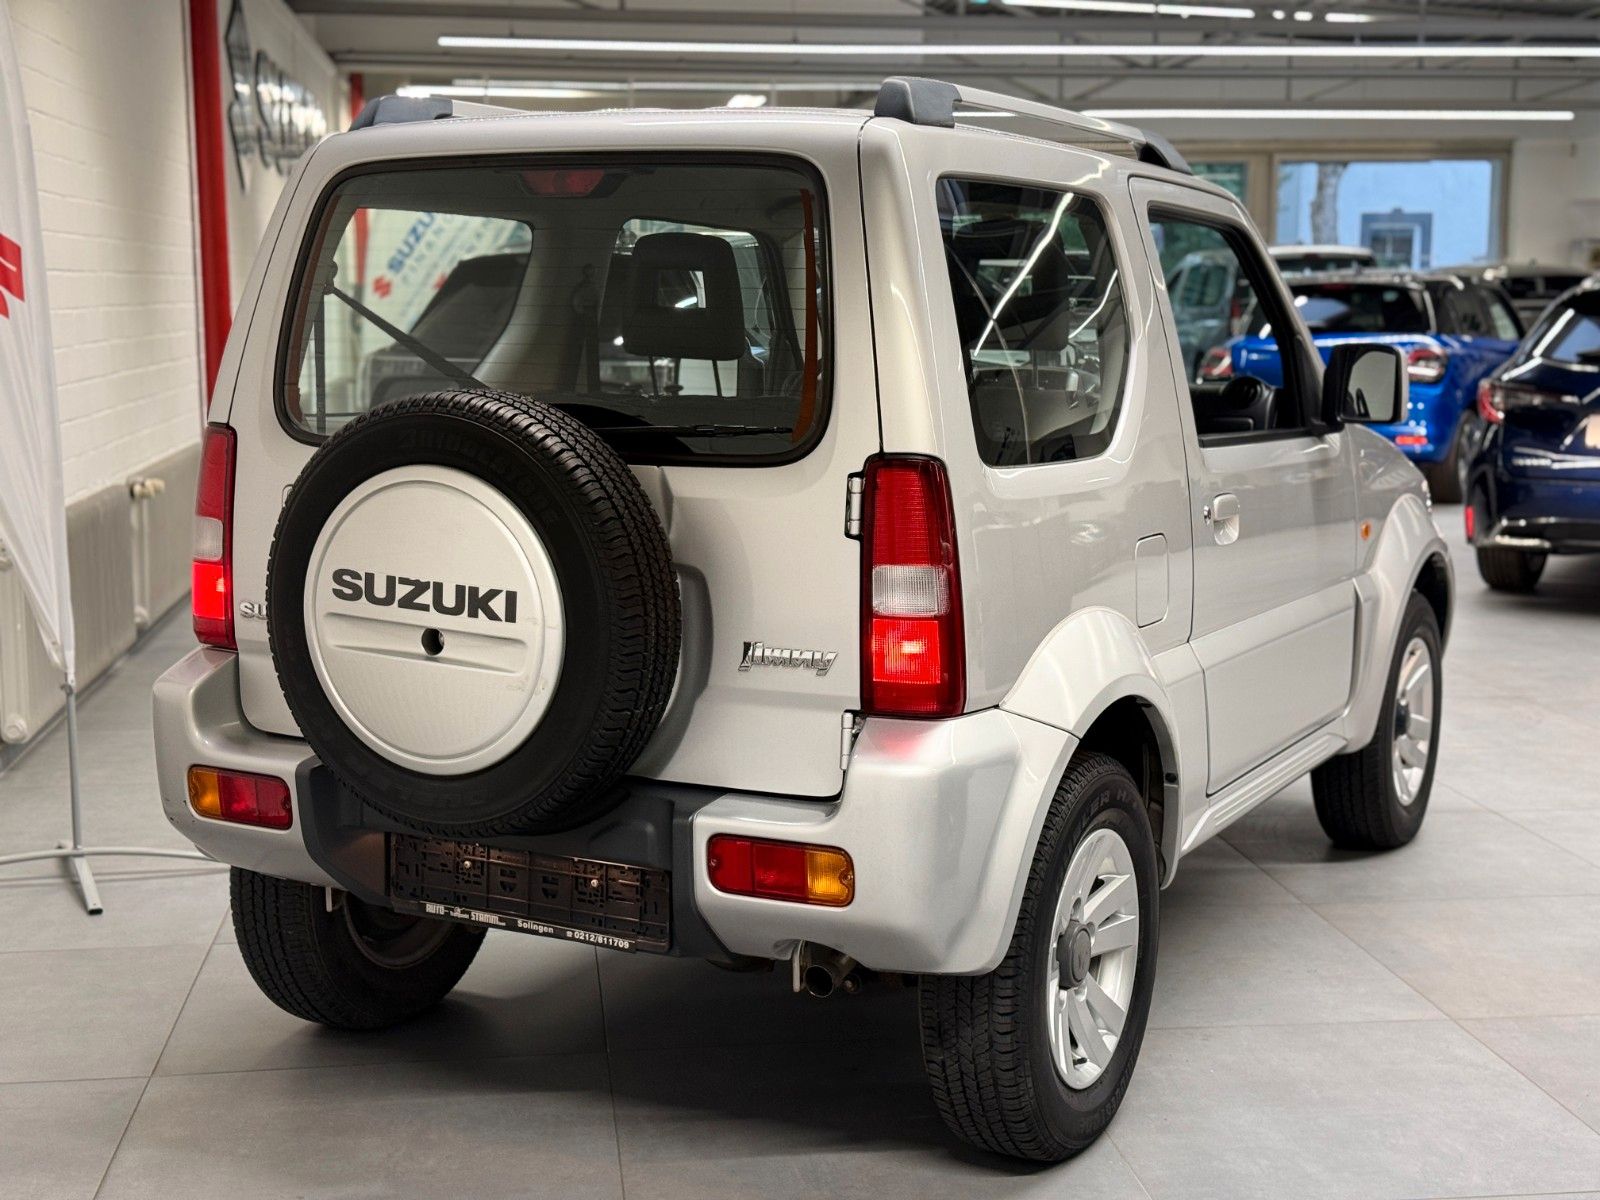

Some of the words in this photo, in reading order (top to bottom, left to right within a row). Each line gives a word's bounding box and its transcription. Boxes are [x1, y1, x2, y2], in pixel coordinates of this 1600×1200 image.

[332, 568, 518, 624] SUZUKI
[738, 641, 838, 676] Jimny
[517, 919, 554, 934] Solingen
